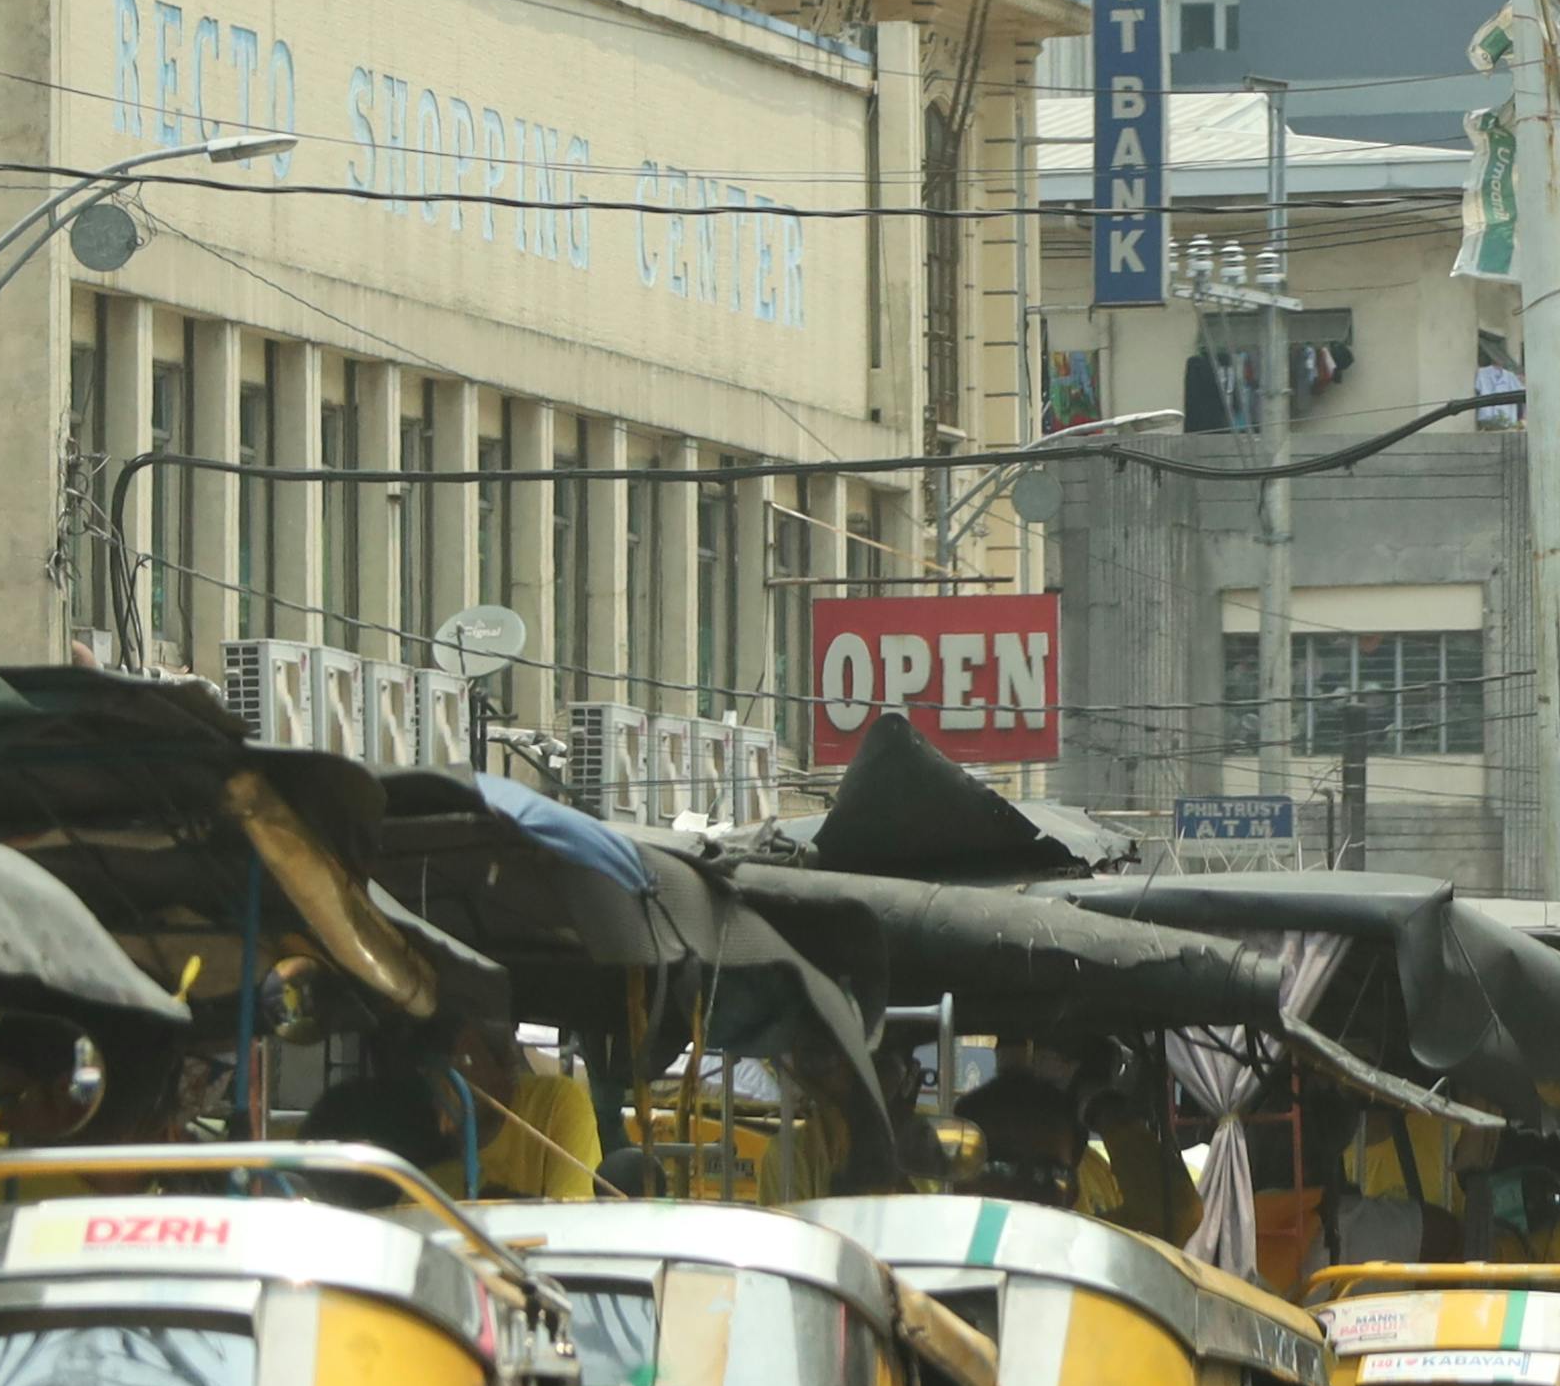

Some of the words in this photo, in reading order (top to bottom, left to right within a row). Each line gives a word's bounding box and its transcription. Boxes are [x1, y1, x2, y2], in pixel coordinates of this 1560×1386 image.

[347, 65, 591, 271] SHOPPING
[636, 159, 805, 330] CENTER
[1109, 76, 1147, 272] BANK
[822, 632, 1048, 731] OPEN
[1183, 801, 1282, 818] PHILTRUST
[84, 1217, 231, 1244] DZRH
[1422, 1354, 1521, 1368] KABAYAN
